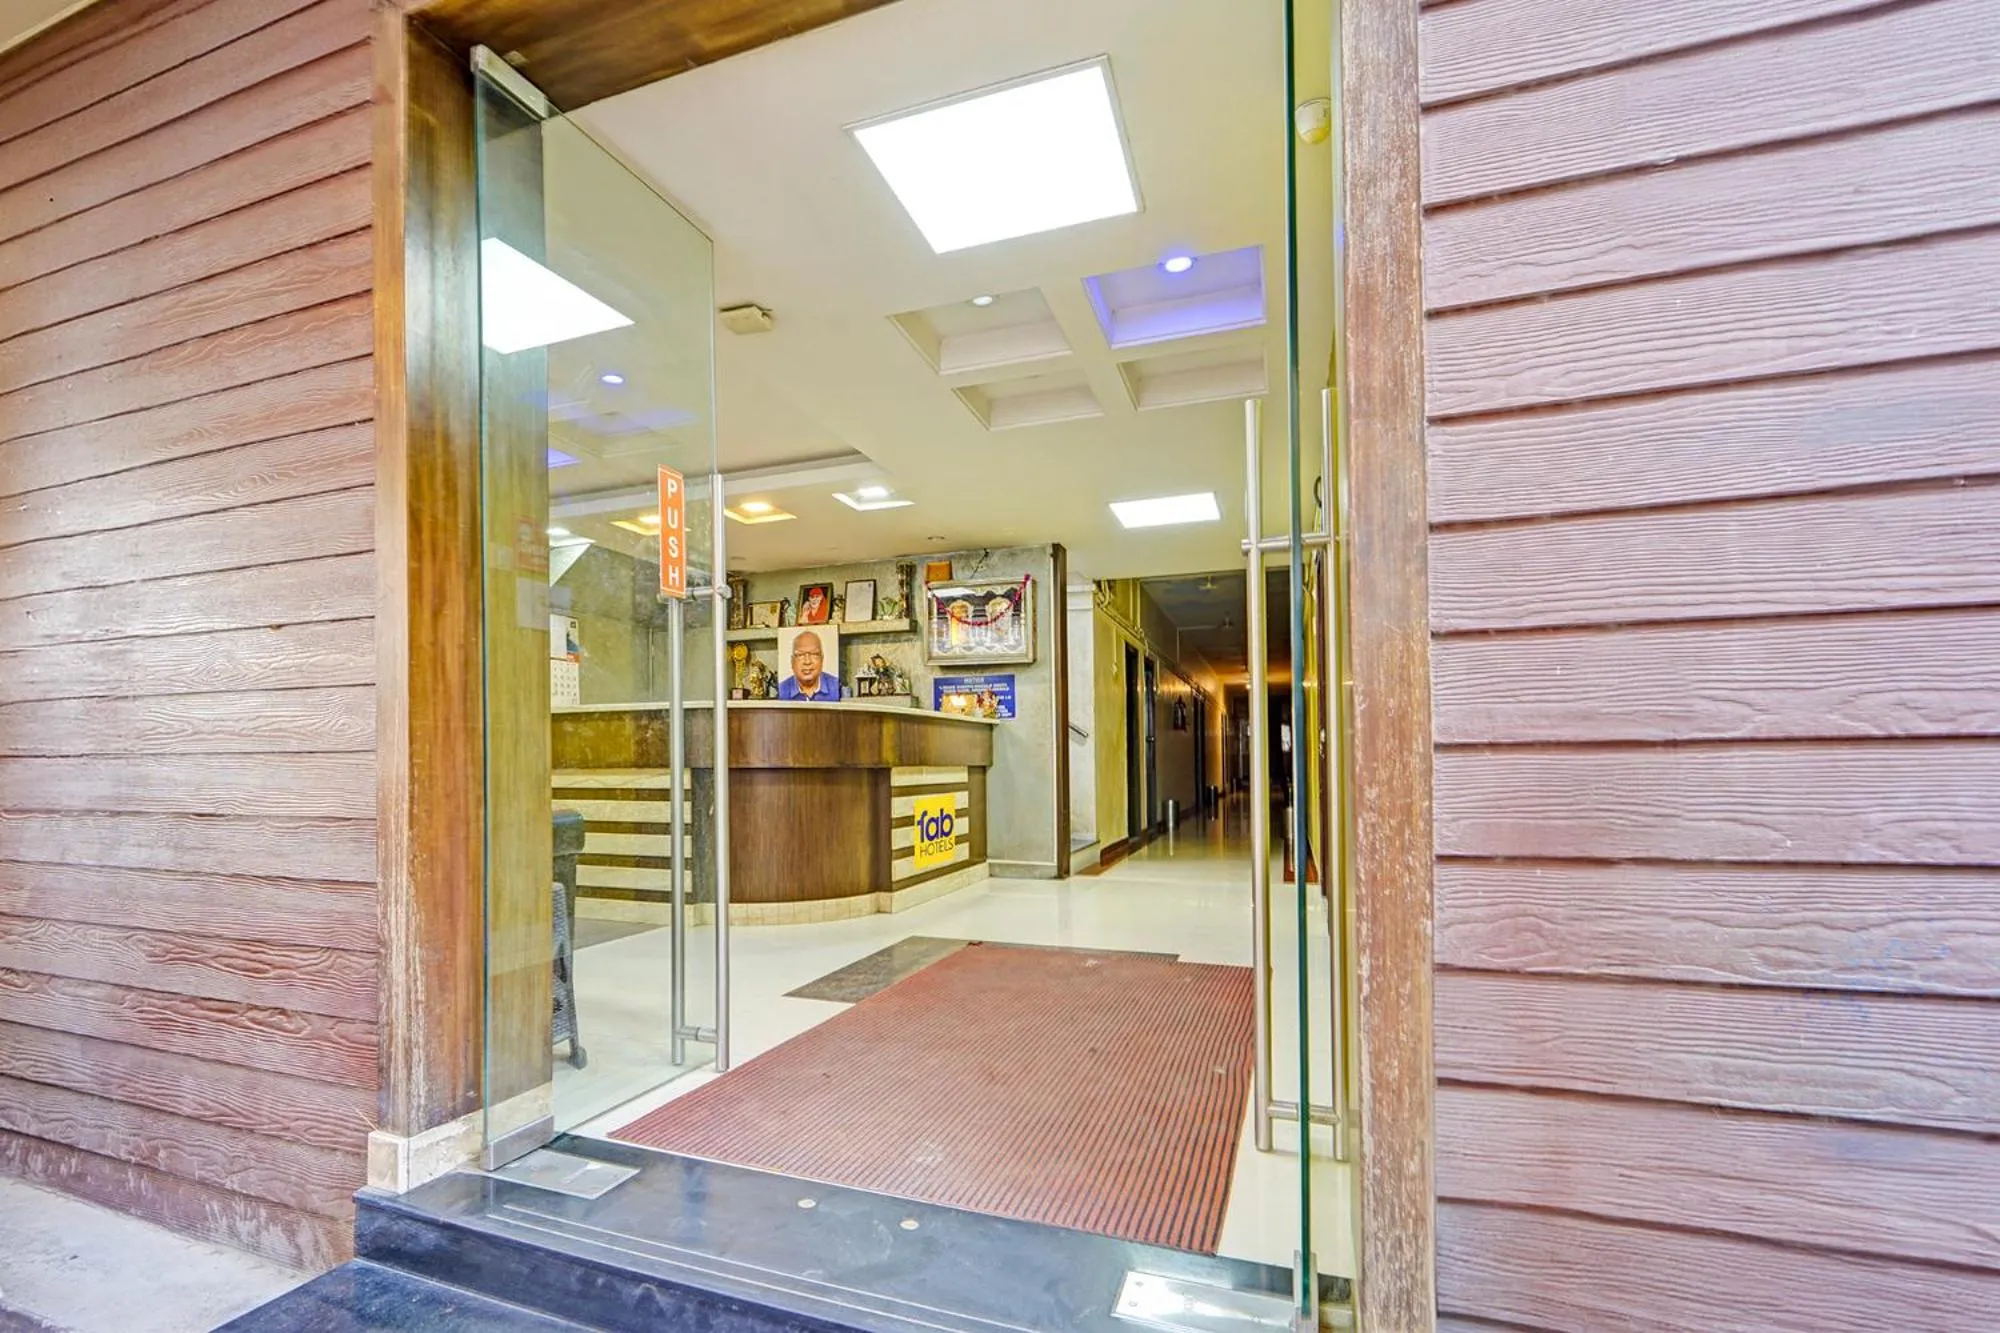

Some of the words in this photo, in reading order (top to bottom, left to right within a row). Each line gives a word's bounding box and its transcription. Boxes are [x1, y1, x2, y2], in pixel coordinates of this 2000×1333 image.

[666, 477, 680, 587] PUSH
[917, 807, 954, 843] fab
[919, 838, 954, 857] HOTELS
